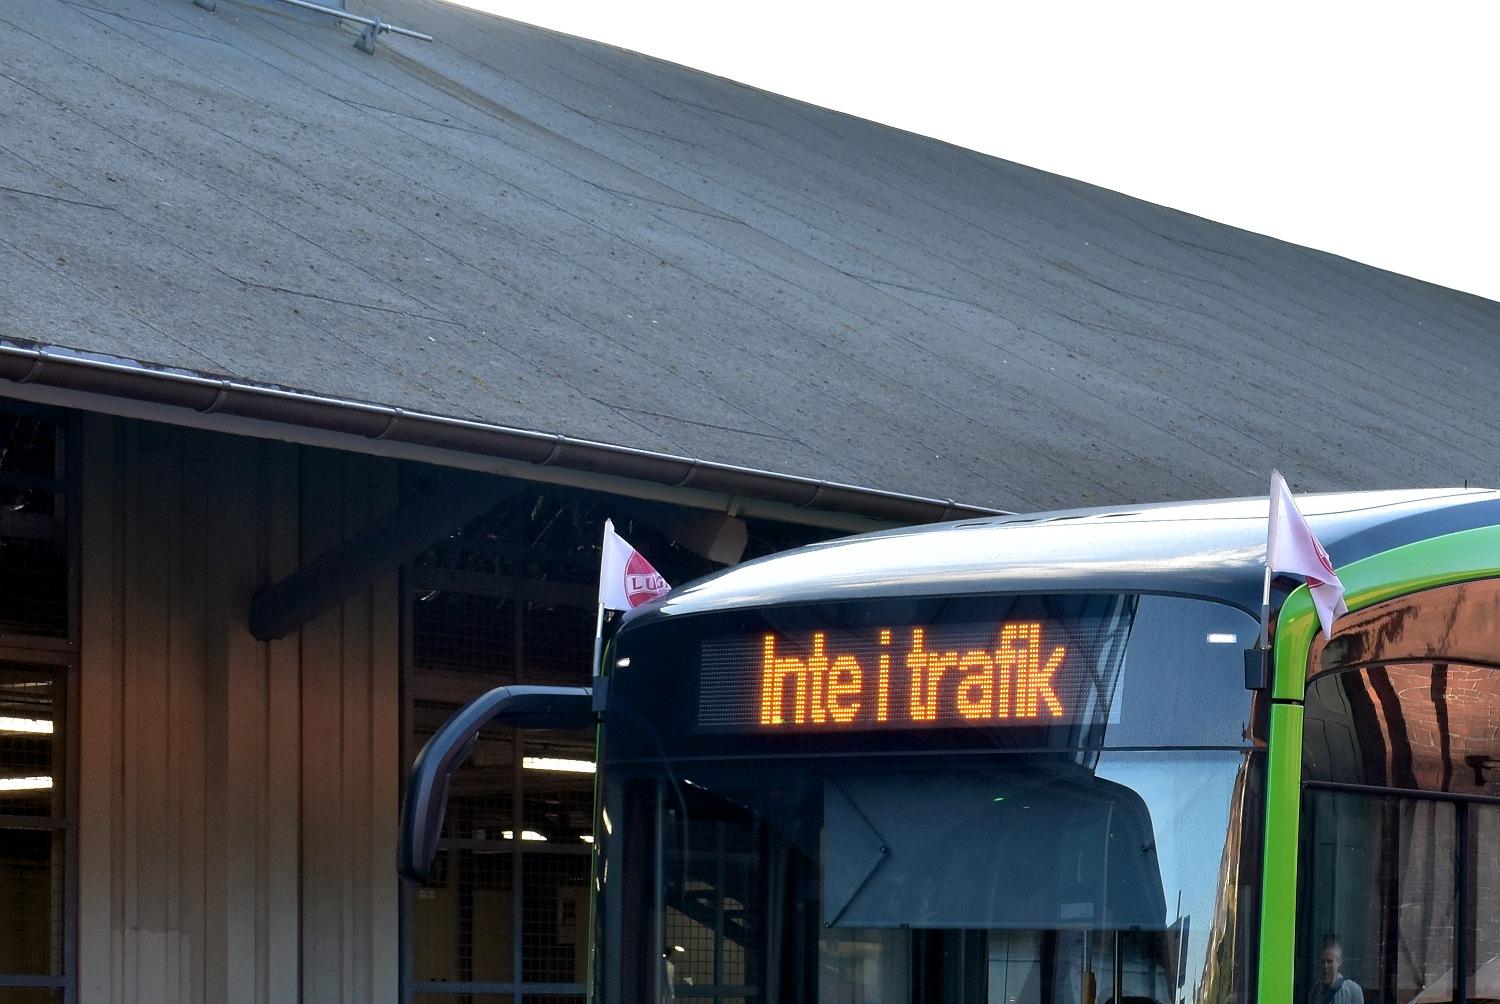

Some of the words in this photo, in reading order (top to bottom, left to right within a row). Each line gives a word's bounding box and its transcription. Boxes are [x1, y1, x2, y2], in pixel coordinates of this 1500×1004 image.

[761, 634, 862, 724] Inte
[877, 629, 891, 721] i
[907, 623, 1065, 720] trafik
